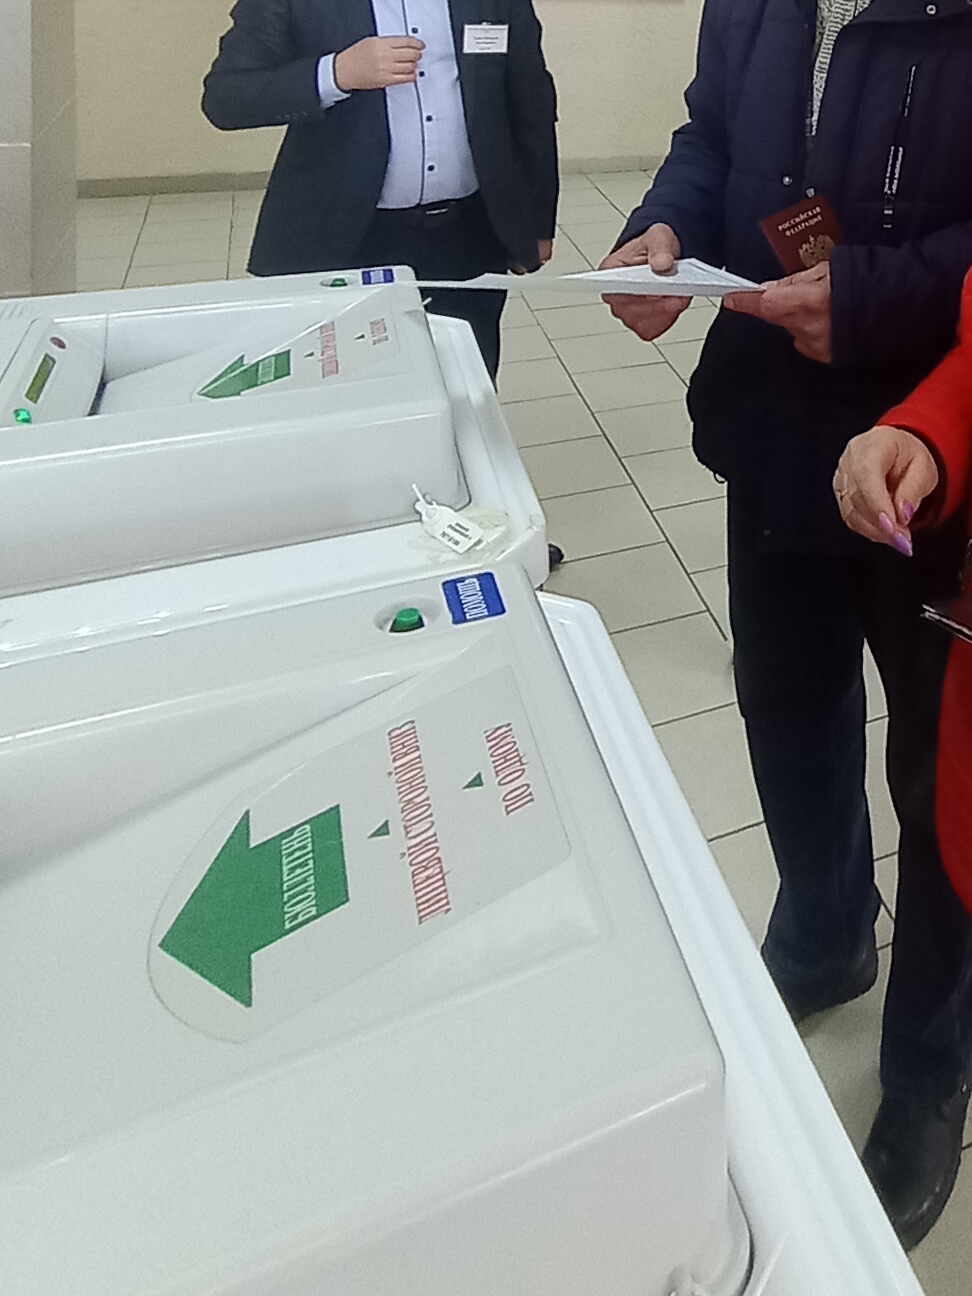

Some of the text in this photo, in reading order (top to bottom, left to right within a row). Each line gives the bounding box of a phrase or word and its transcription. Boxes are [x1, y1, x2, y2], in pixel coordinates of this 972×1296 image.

[456, 577, 489, 620] ПОМОЩЬ
[484, 722, 534, 816] ПО ОДНОМУ
[387, 720, 451, 925] ЛИЦЕВОЙ СТОРОНОЙ ВНИЗ
[281, 824, 317, 930] БЮЛЛЕТЕНЬ
